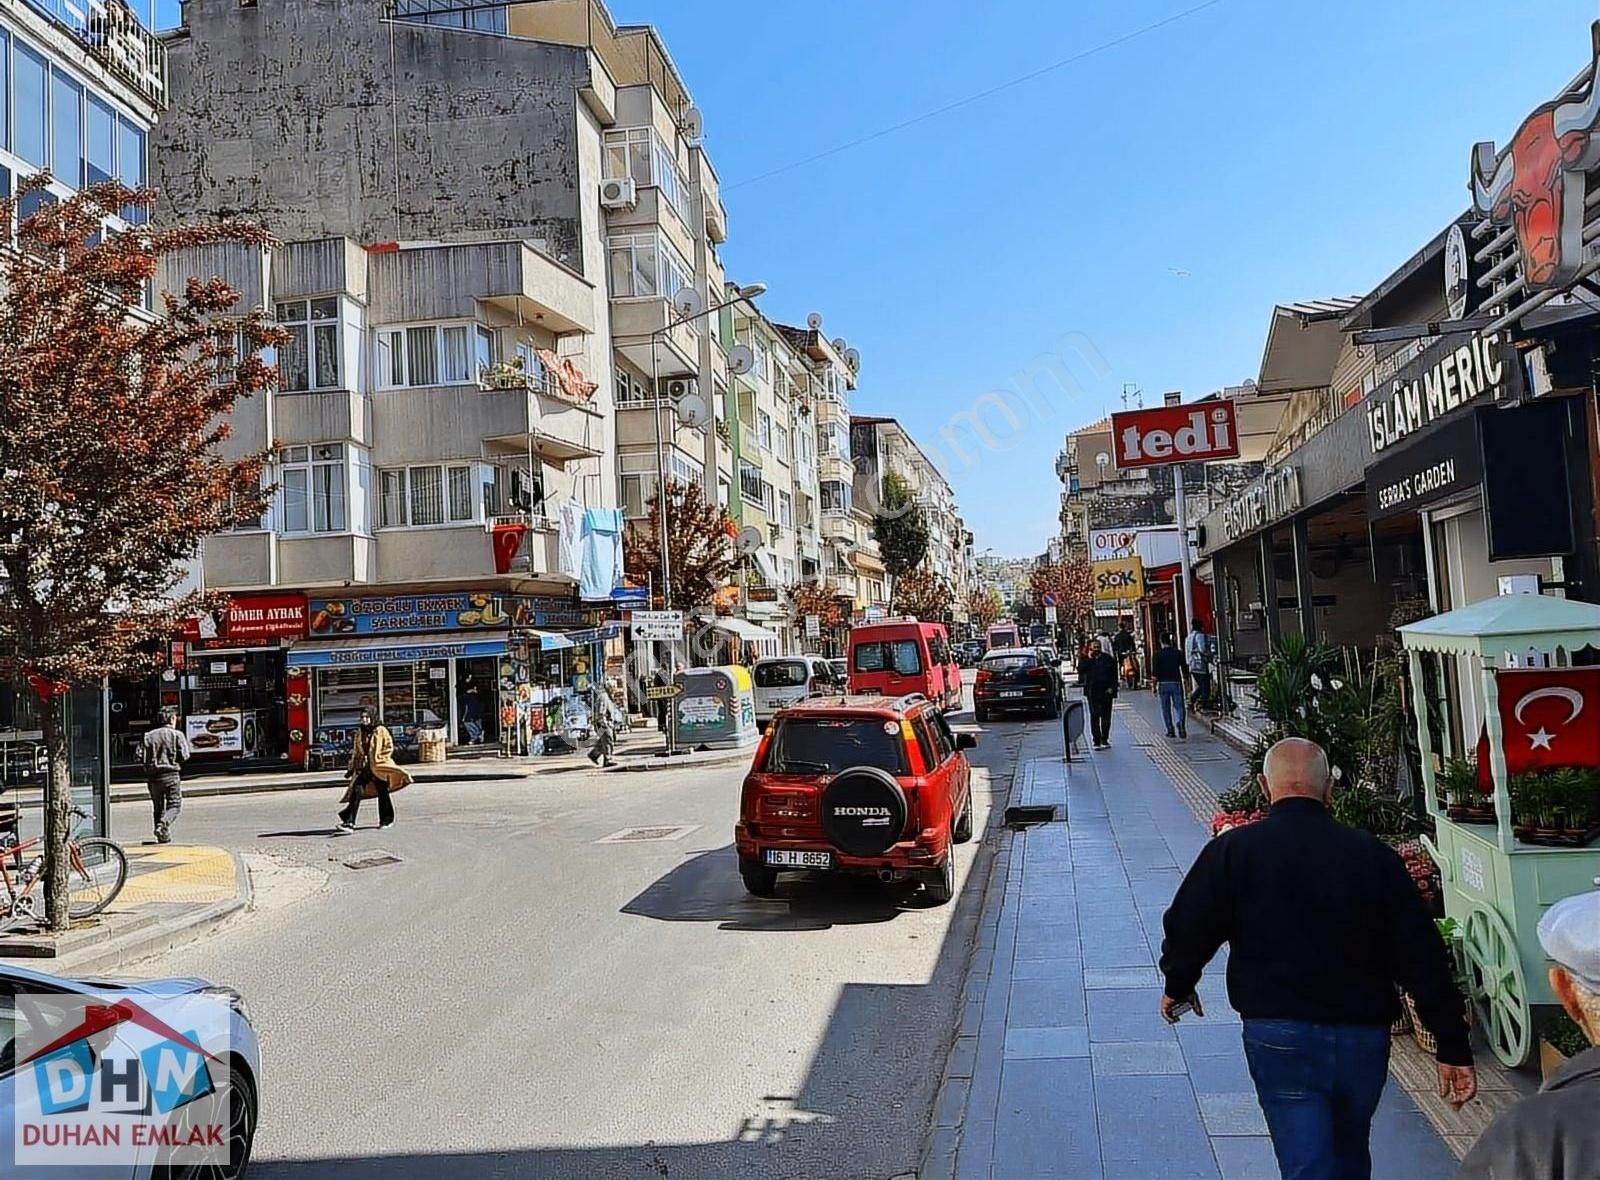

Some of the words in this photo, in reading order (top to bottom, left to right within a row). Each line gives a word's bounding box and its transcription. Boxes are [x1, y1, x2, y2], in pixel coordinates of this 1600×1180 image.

[1367, 381, 1423, 453] İSLÂM
[1423, 330, 1502, 421] MERİÇ
[1122, 408, 1231, 460] tedi
[1379, 478, 1411, 510] SERRA'S
[1414, 458, 1455, 496] GARDEN
[417, 598, 464, 612] EKMEK
[230, 606, 264, 621] ÖMER
[267, 607, 303, 620] AYBAK
[833, 807, 891, 816] HONDA
[802, 852, 829, 865] 8652
